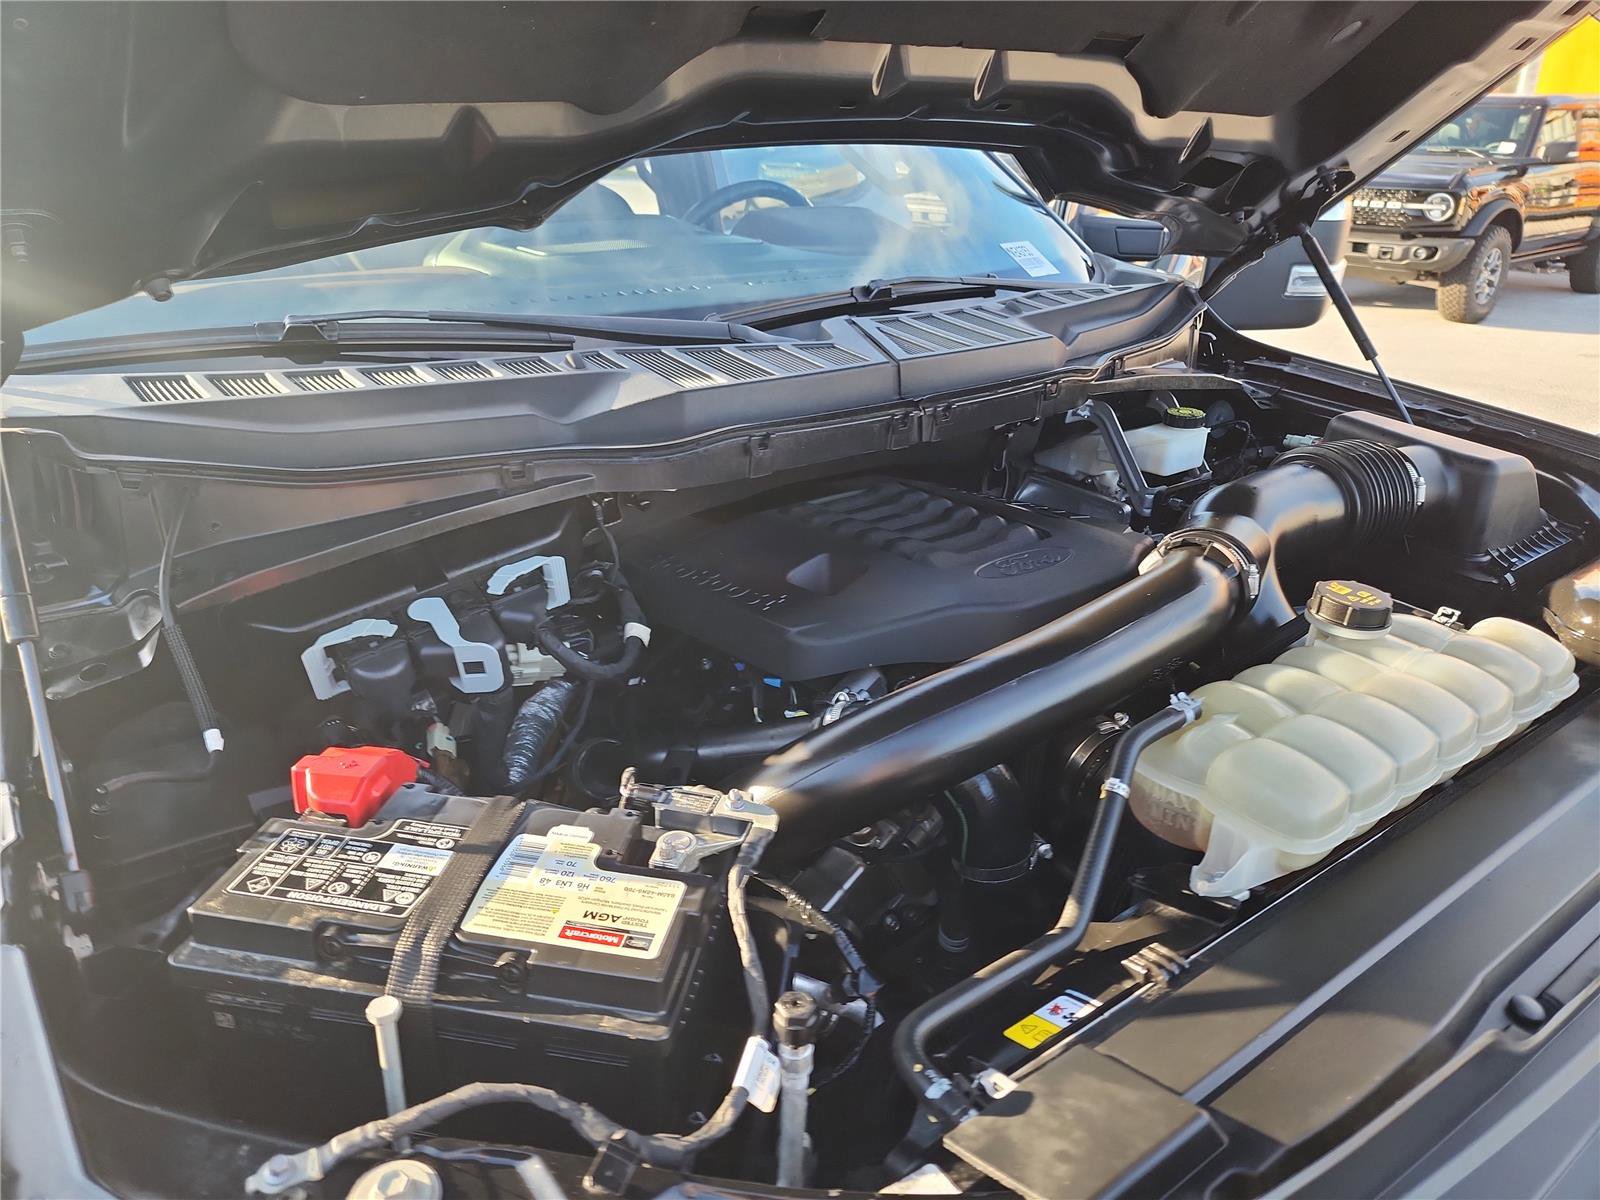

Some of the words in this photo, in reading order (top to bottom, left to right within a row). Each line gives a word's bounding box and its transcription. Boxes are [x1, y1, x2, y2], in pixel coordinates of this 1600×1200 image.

[286, 891, 381, 910] DANGER/POISON
[583, 911, 622, 922] AGM
[565, 929, 619, 943] Motorcraft
